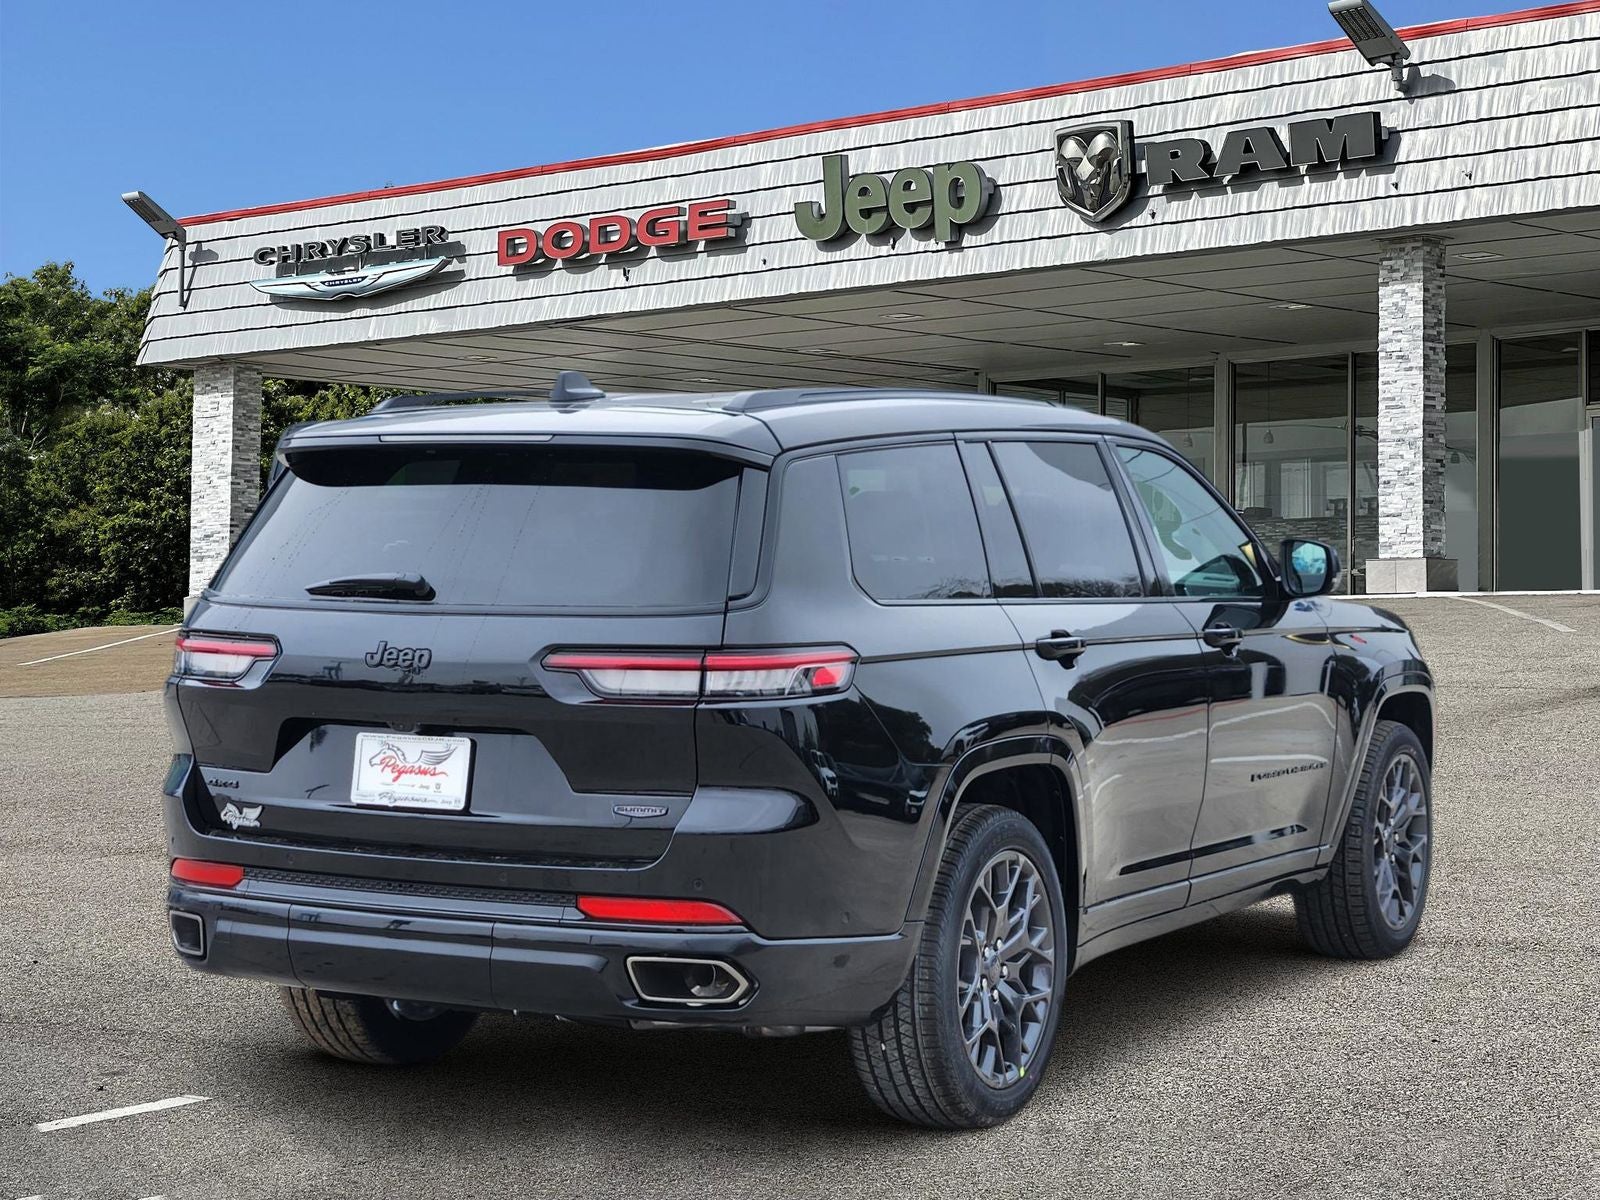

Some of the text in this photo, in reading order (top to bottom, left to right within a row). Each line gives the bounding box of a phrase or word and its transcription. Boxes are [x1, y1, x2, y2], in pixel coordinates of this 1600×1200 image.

[1145, 111, 1382, 187] RAM
[794, 154, 989, 243] Jeep
[253, 225, 447, 266] CHRYSLER
[497, 199, 737, 267] DODGE
[324, 276, 363, 287] CHRYSLER
[364, 640, 433, 674] Jeep
[380, 755, 449, 783] Pegasus
[615, 806, 664, 814] SUMMIT
